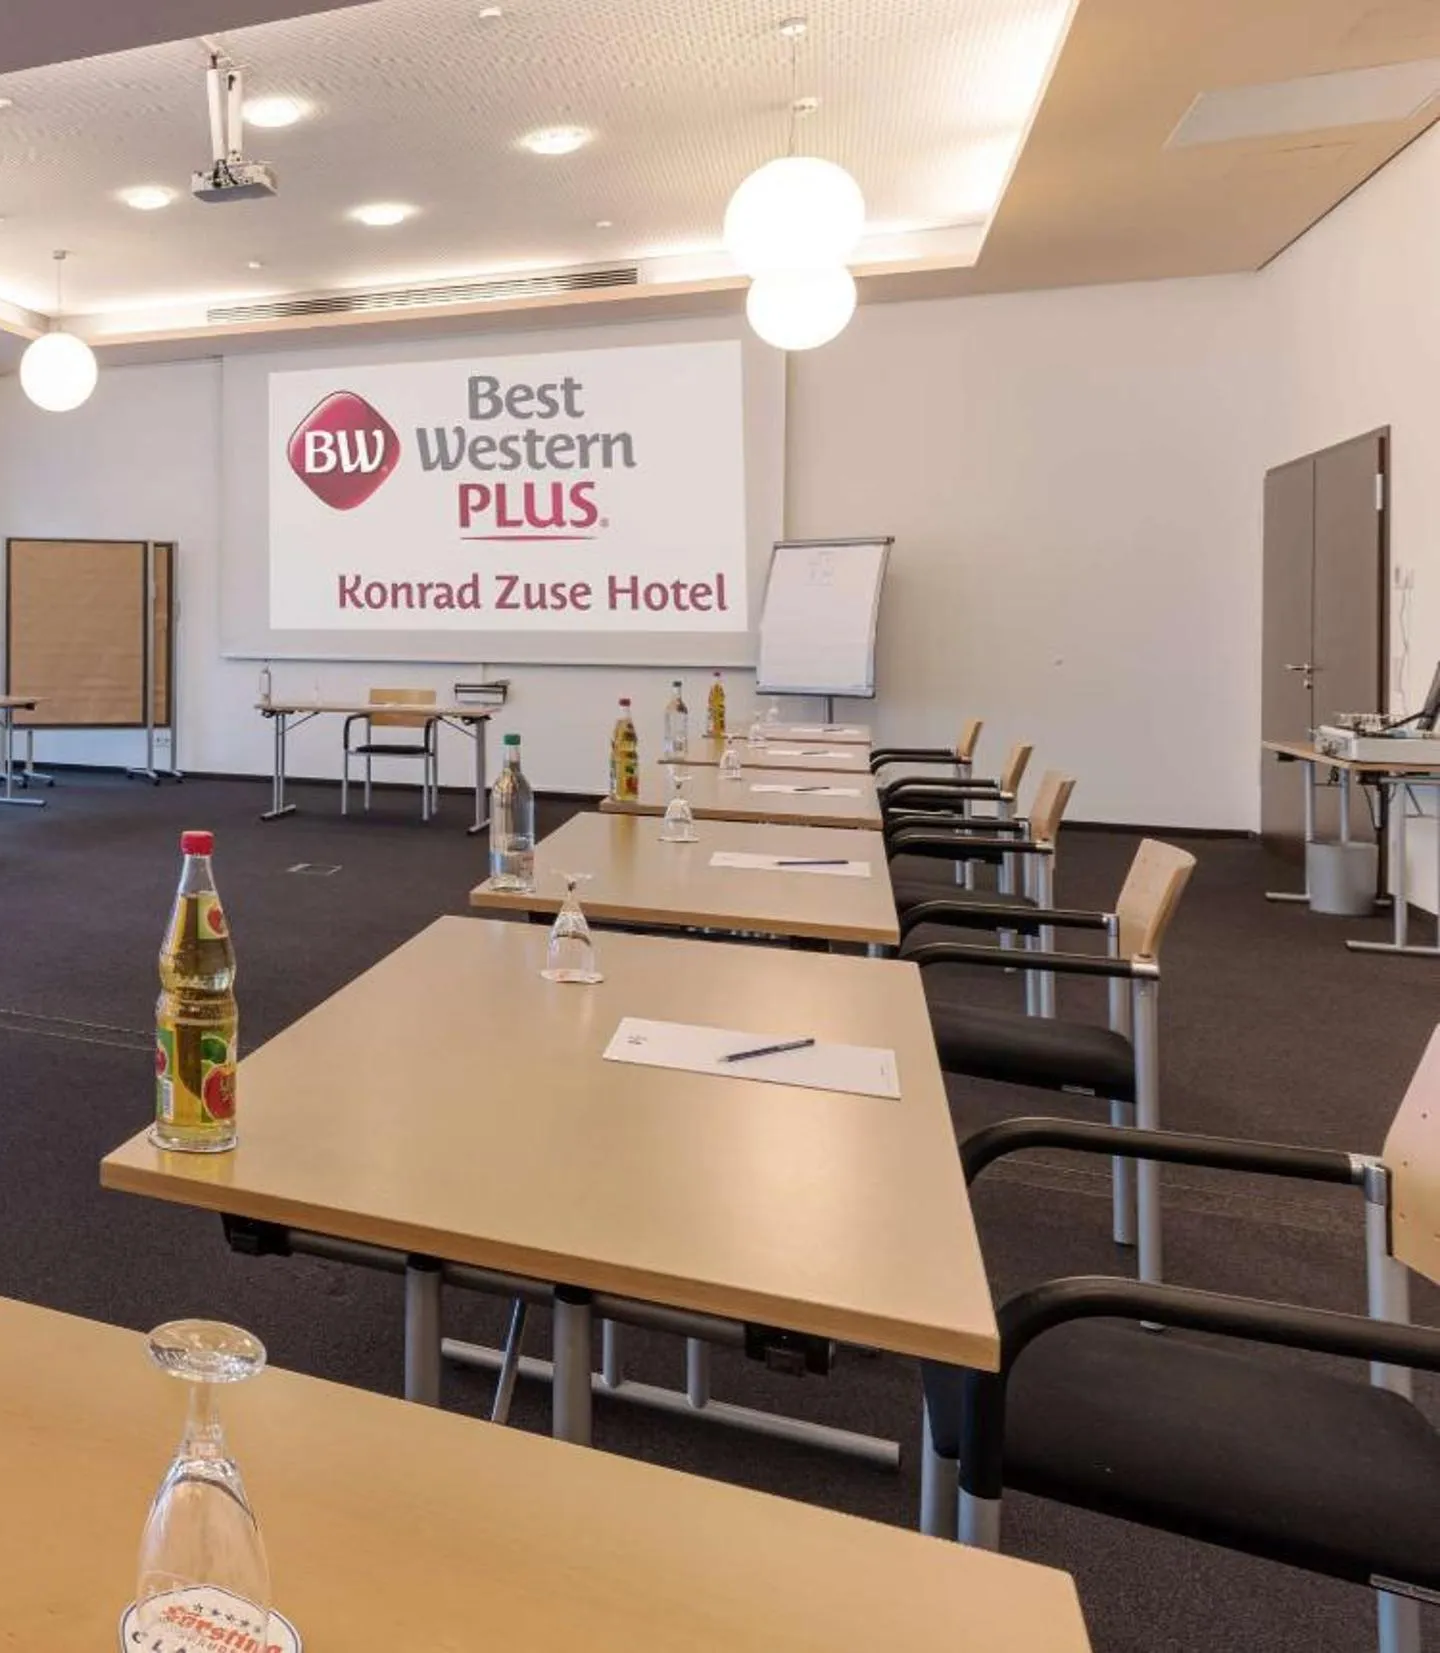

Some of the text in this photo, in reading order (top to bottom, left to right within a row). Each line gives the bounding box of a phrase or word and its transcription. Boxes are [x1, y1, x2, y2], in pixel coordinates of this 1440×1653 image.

[468, 375, 585, 421] Best
[304, 429, 385, 473] BW
[416, 426, 637, 472] Western
[458, 481, 599, 529] PLUS
[338, 572, 728, 612] Konrad Zuse Hotel
